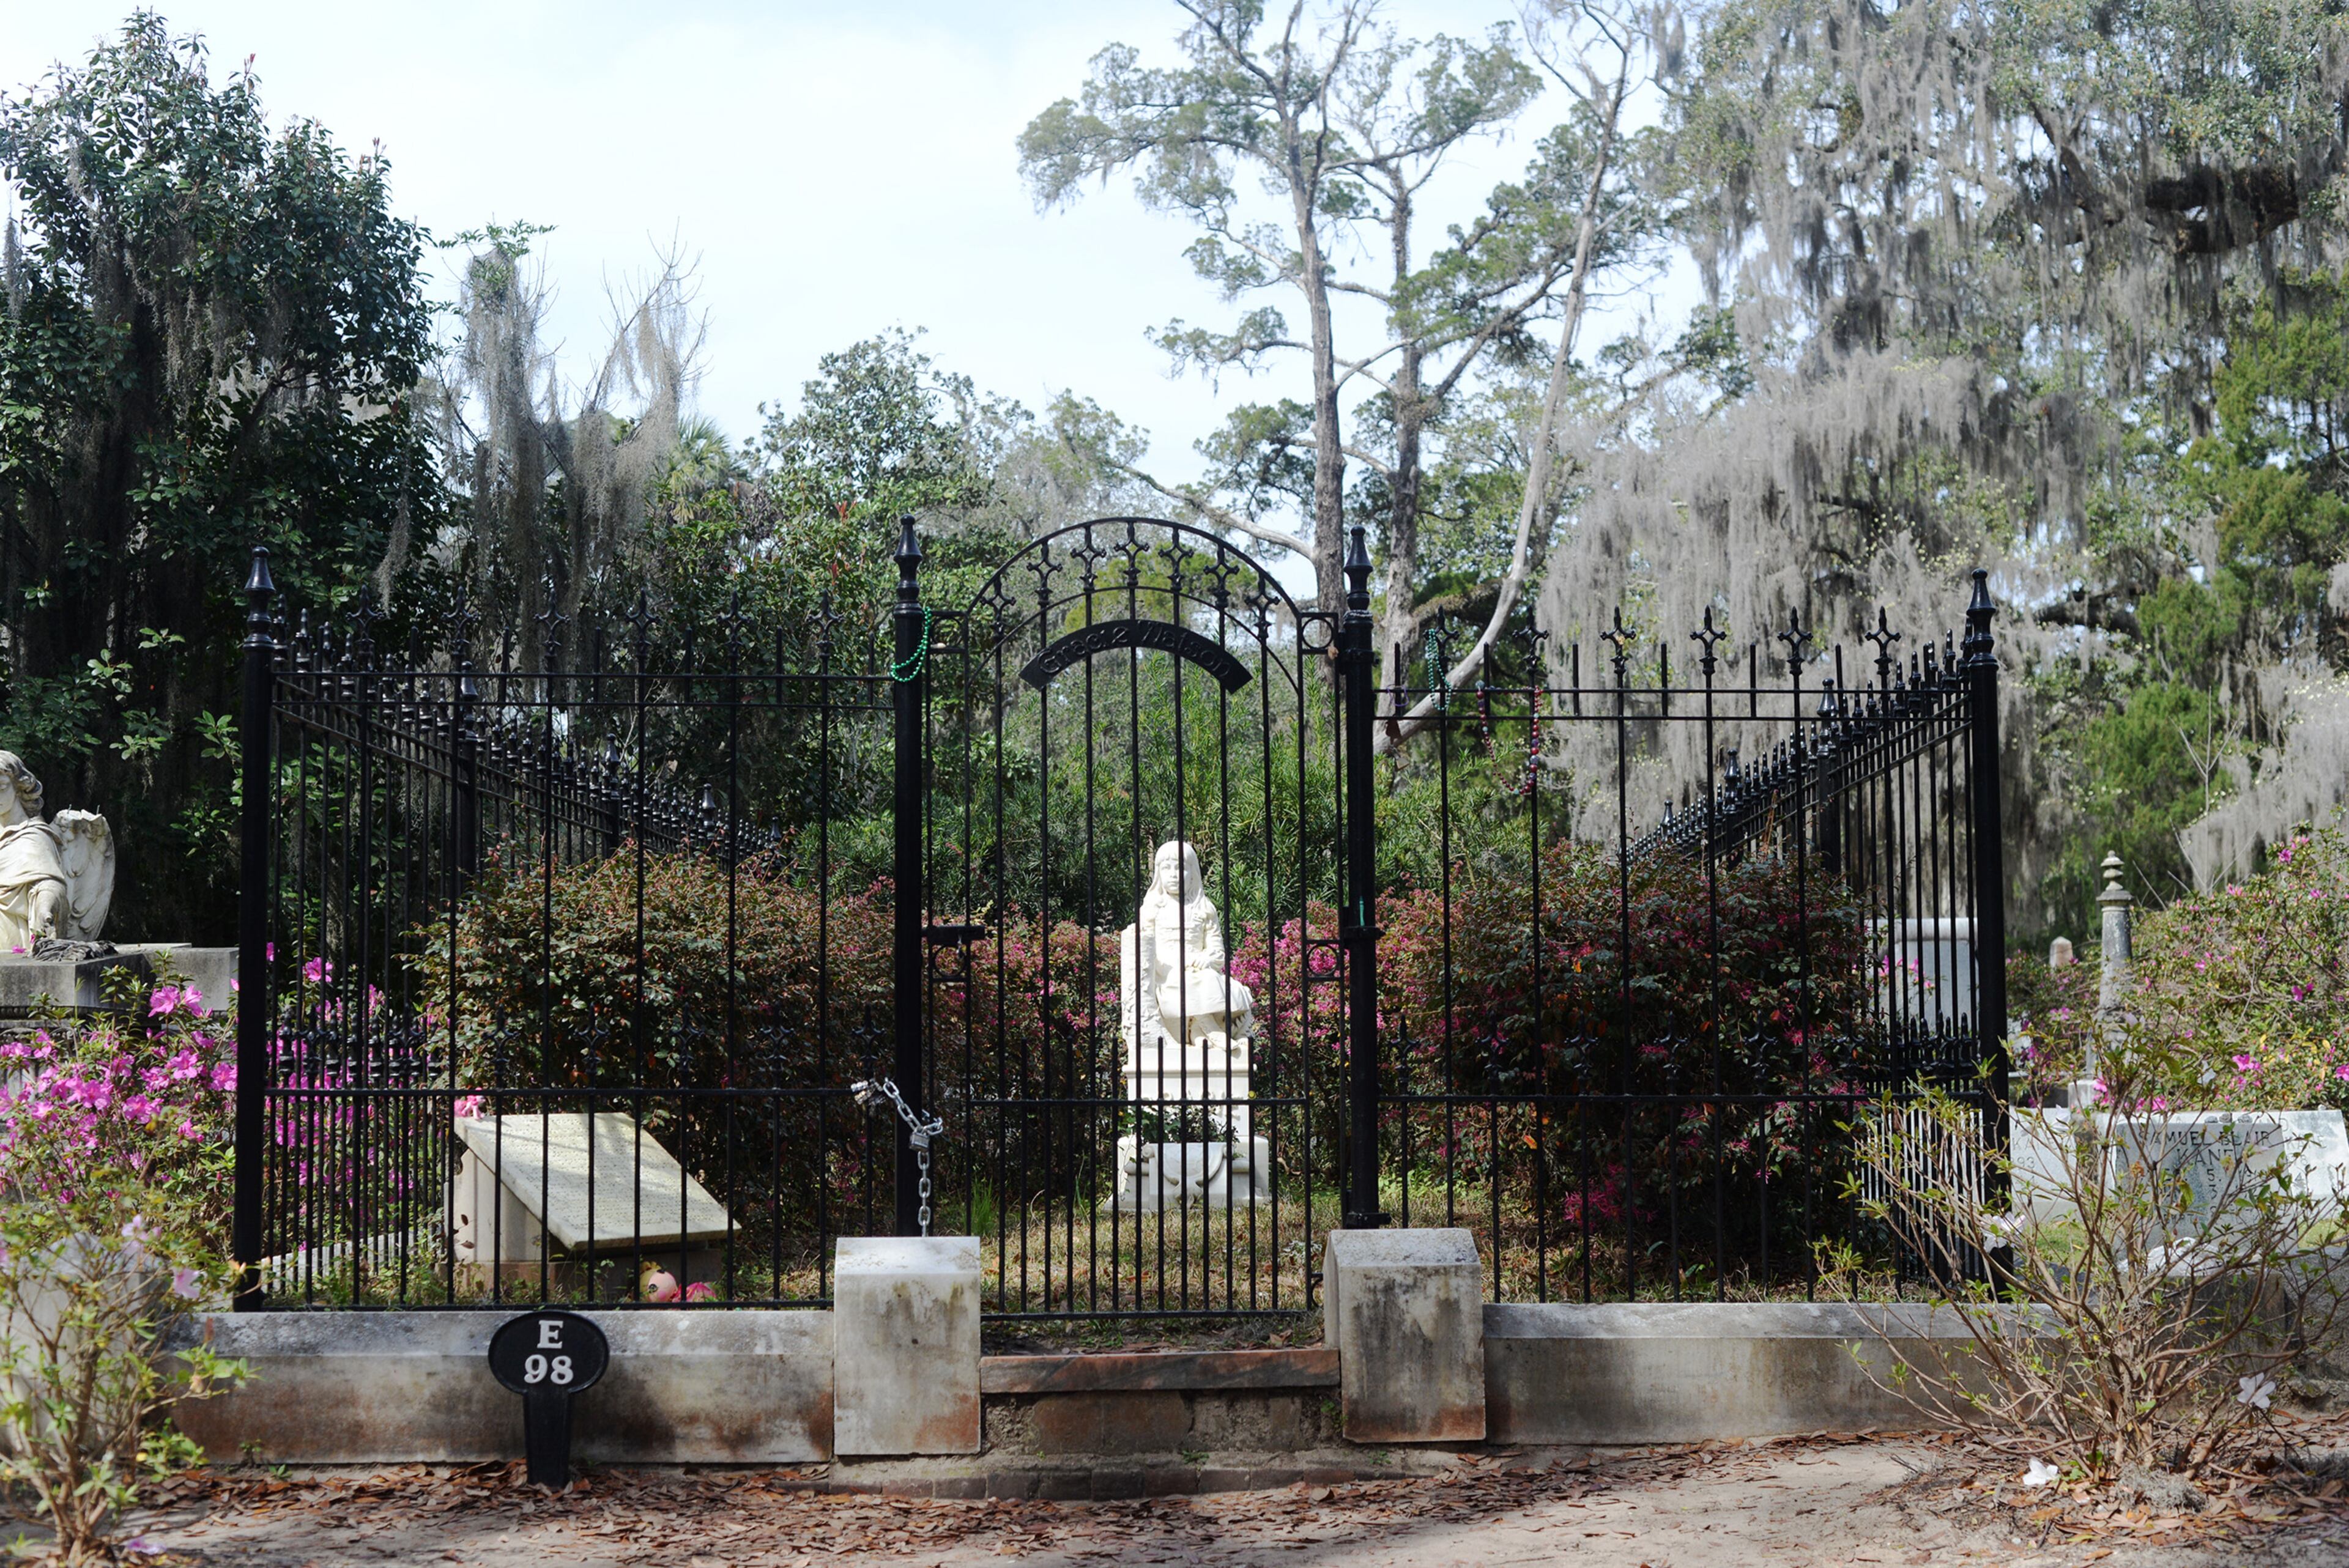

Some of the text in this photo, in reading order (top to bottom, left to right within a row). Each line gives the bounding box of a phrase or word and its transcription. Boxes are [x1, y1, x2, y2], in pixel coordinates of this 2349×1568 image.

[1037, 620, 1232, 678] Gracie Watson
[2139, 1131, 2273, 1147] SAMUEL BLAIR
[536, 1320, 564, 1349] E
[524, 1354, 574, 1385] 98
